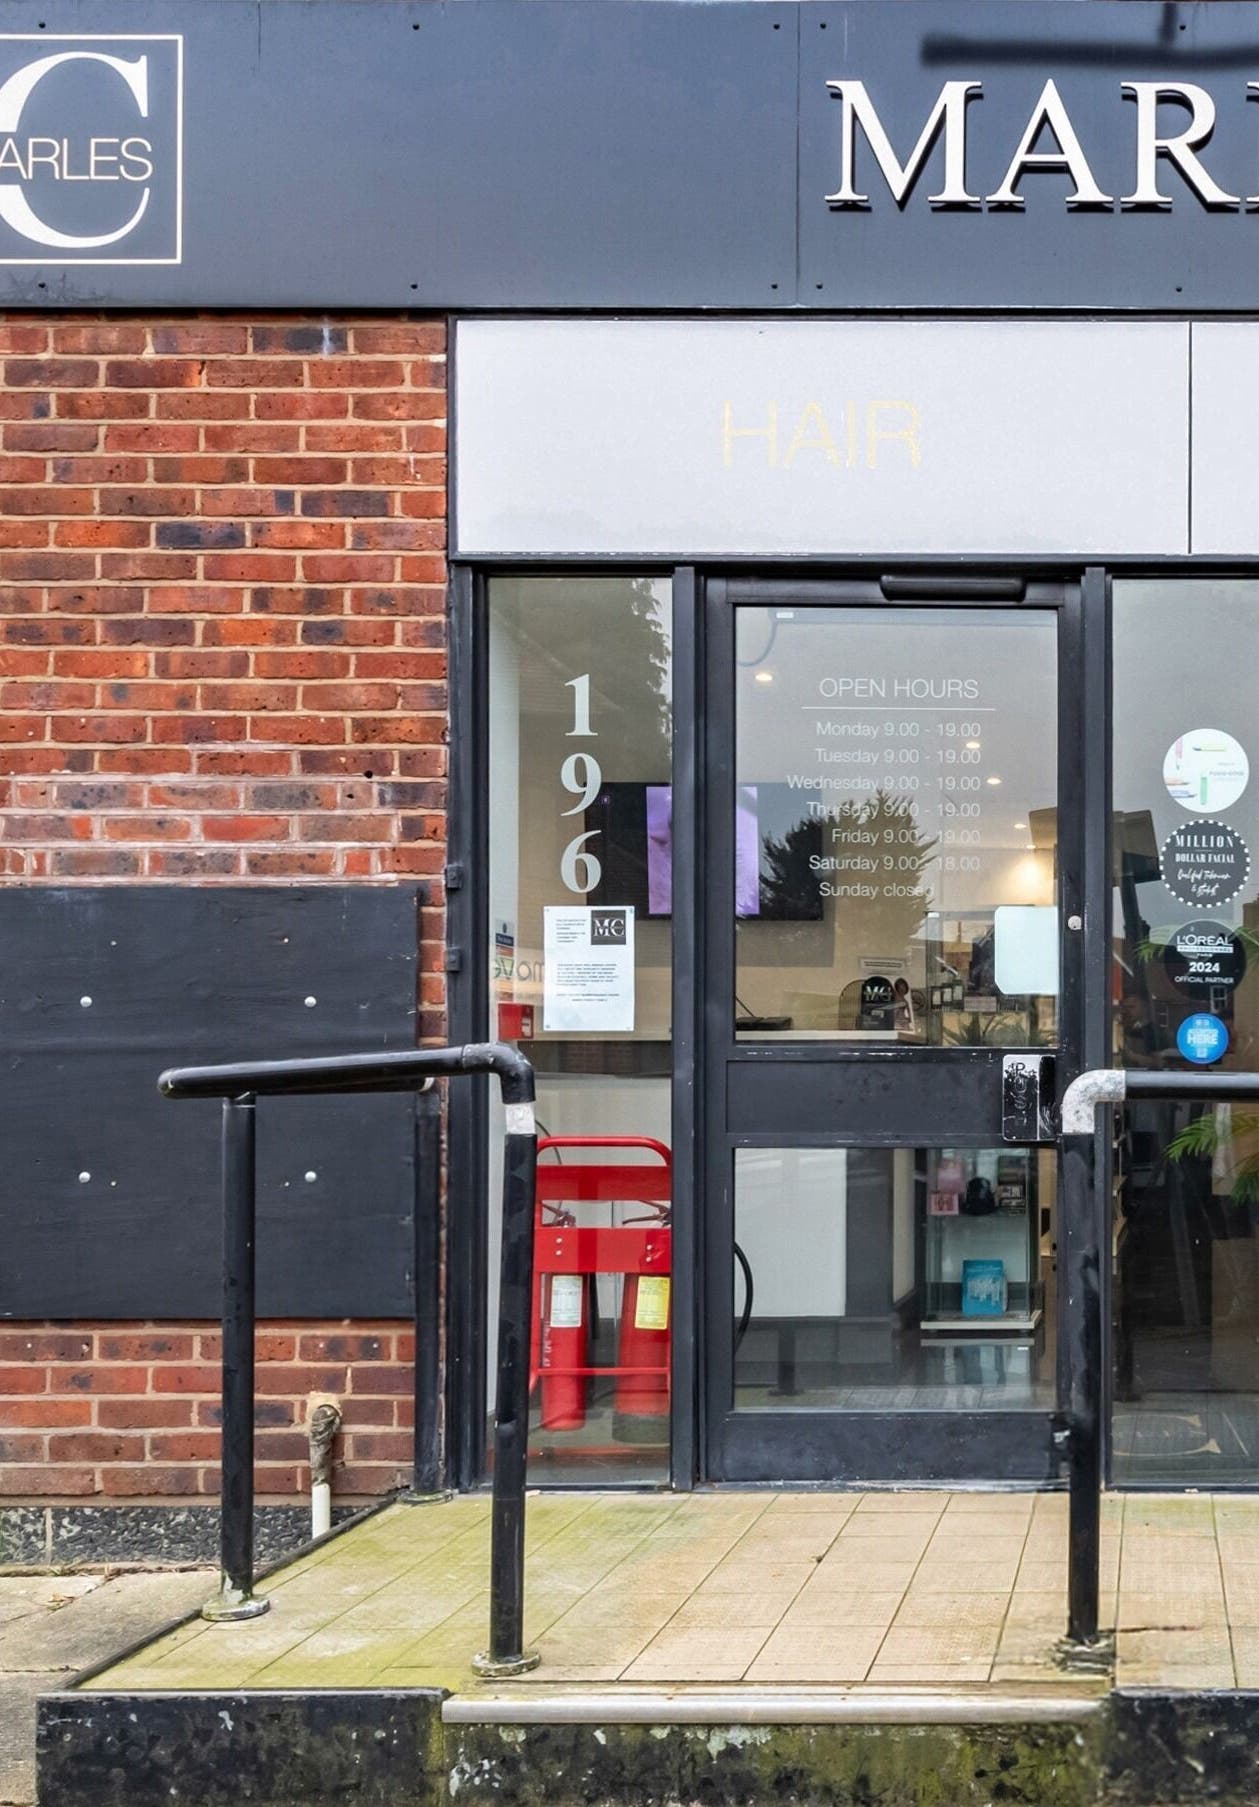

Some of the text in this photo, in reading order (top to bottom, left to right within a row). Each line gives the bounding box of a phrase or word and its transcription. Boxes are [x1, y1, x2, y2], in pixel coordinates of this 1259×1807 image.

[0, 137, 153, 182] ARLES
[722, 399, 922, 469] HAIR
[819, 677, 979, 699] OPEN HOURS
[816, 722, 879, 739] Monday
[884, 722, 919, 736] 9.00
[937, 722, 981, 737] 19.00
[815, 748, 879, 765] Tuesday
[884, 749, 919, 763] 9.00
[937, 749, 981, 764] 19.00
[787, 776, 879, 792] Wednesday
[884, 776, 919, 790] 9.00
[937, 776, 981, 791] 19.00
[807, 802, 879, 819] Thursday
[884, 803, 919, 817] 9.00
[937, 803, 981, 818] 19.00
[832, 829, 879, 846] Friday
[884, 829, 919, 843] 9.00
[1175, 835, 1235, 848] MILLION
[809, 855, 879, 872] Saturday
[884, 856, 919, 870] 9.00
[1175, 852, 1236, 864] DOLLAR FACIAL
[819, 883, 935, 900] Sunday closed
[1189, 961, 1220, 973] 2024
